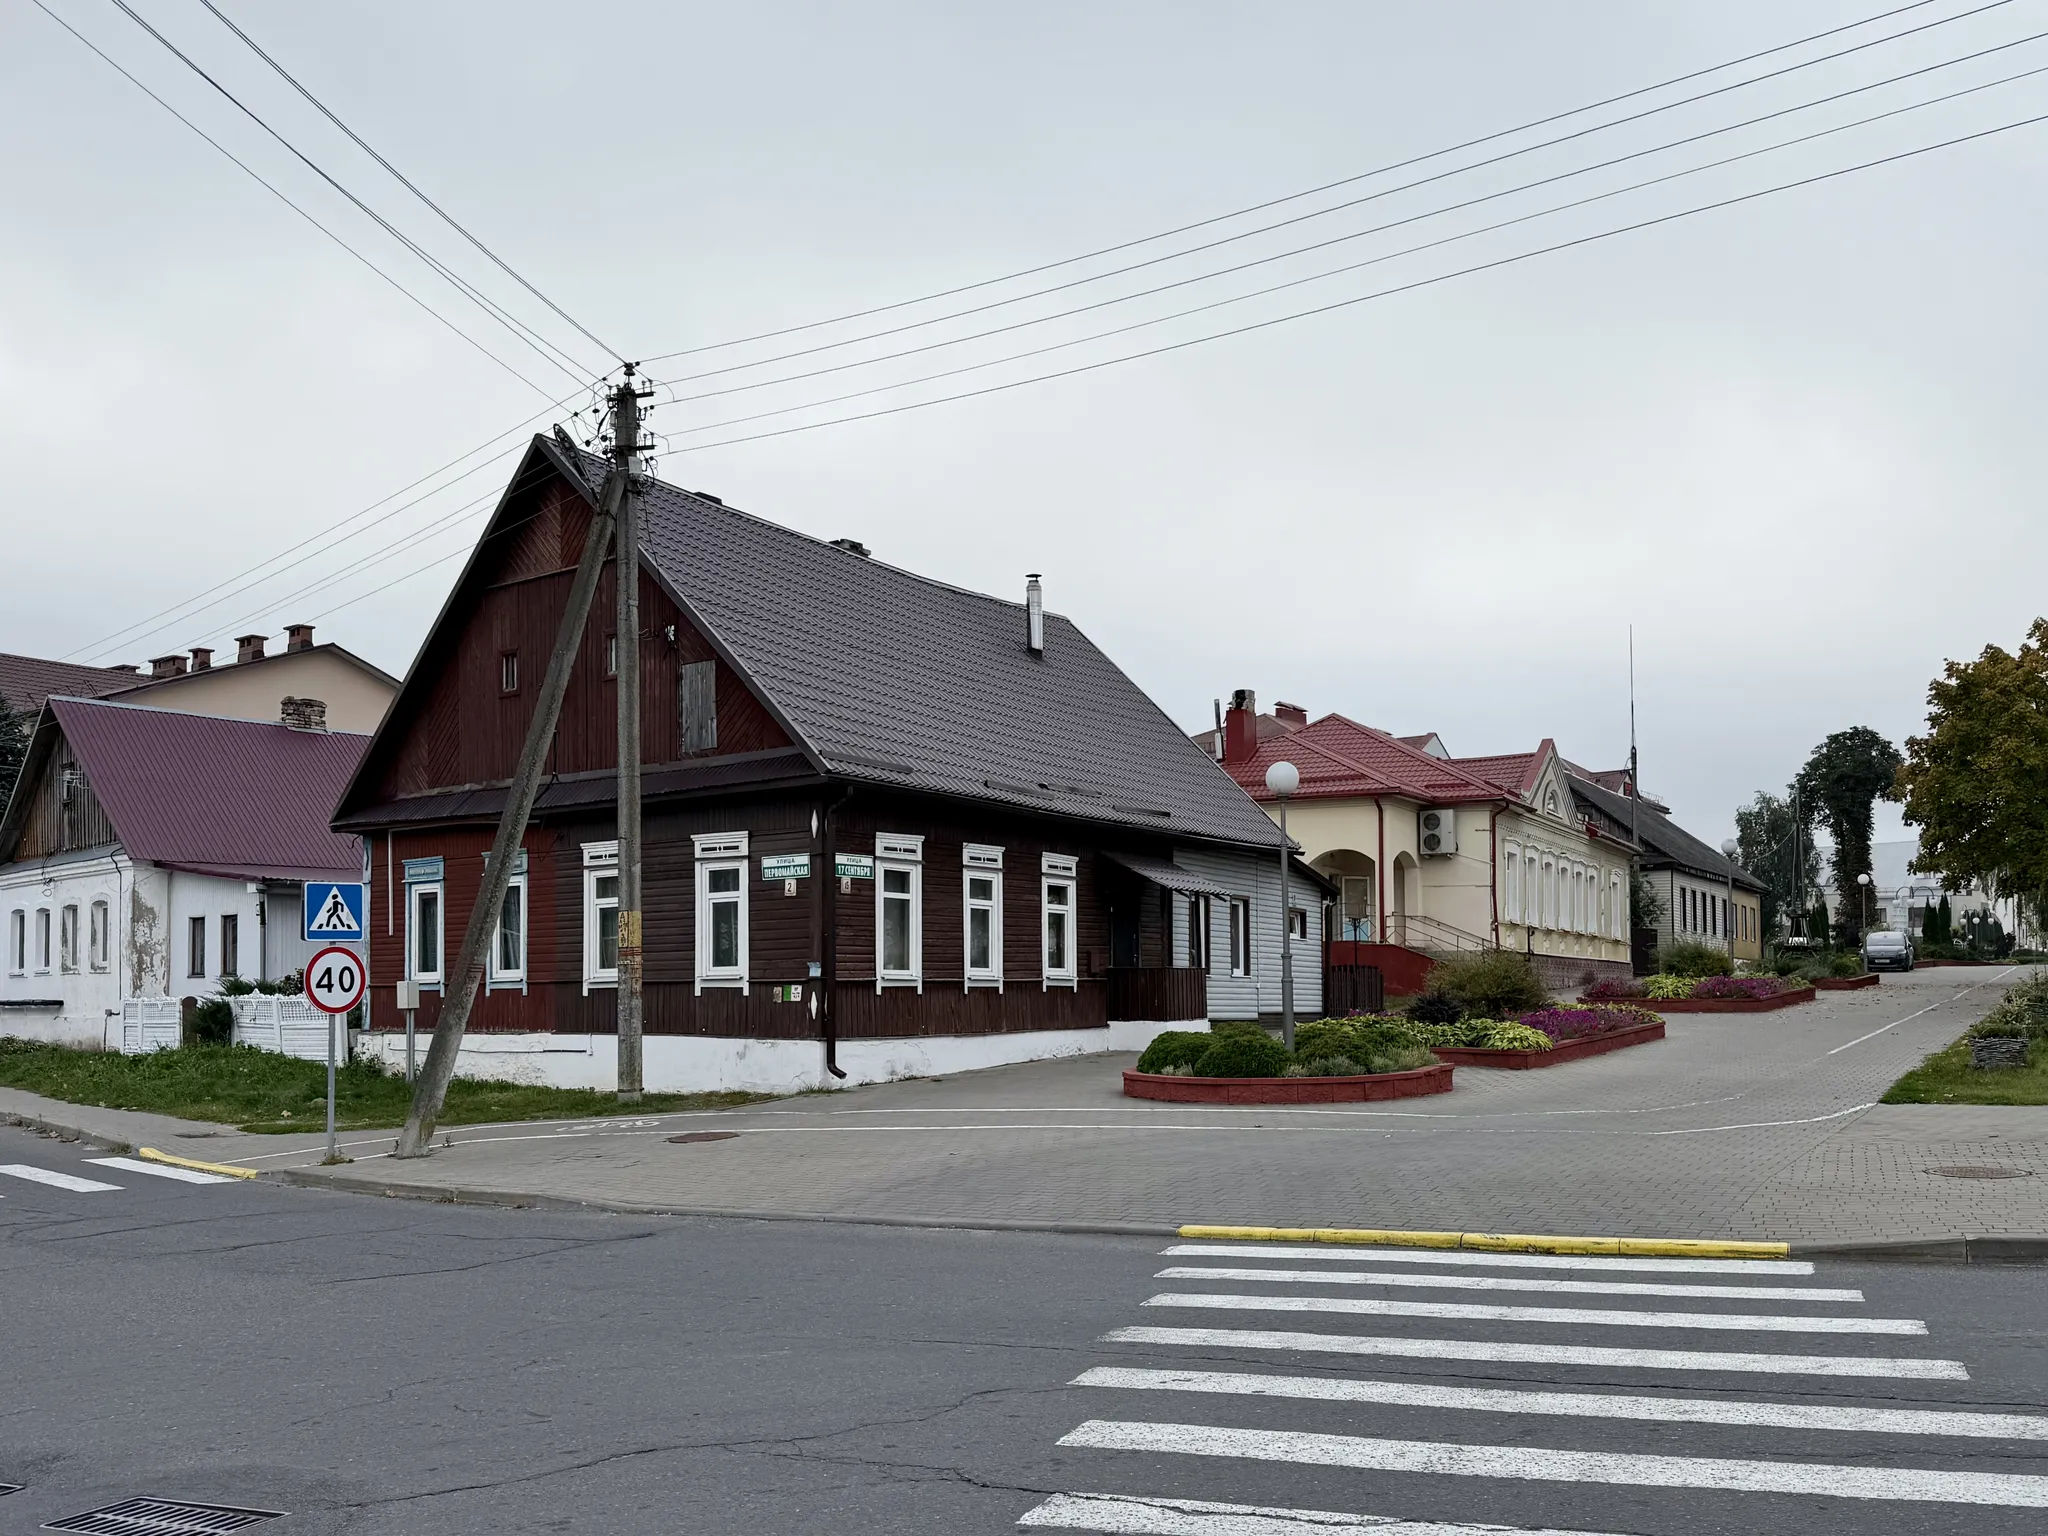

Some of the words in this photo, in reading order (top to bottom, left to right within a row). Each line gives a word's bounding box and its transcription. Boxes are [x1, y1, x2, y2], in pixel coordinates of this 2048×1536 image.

[764, 865, 808, 878] ПЕРВОМАЙСКАЯ
[838, 865, 845, 874] 17
[845, 865, 870, 876] СЕНТЯБРЯ
[787, 882, 792, 892] 2
[316, 966, 355, 993] 40
